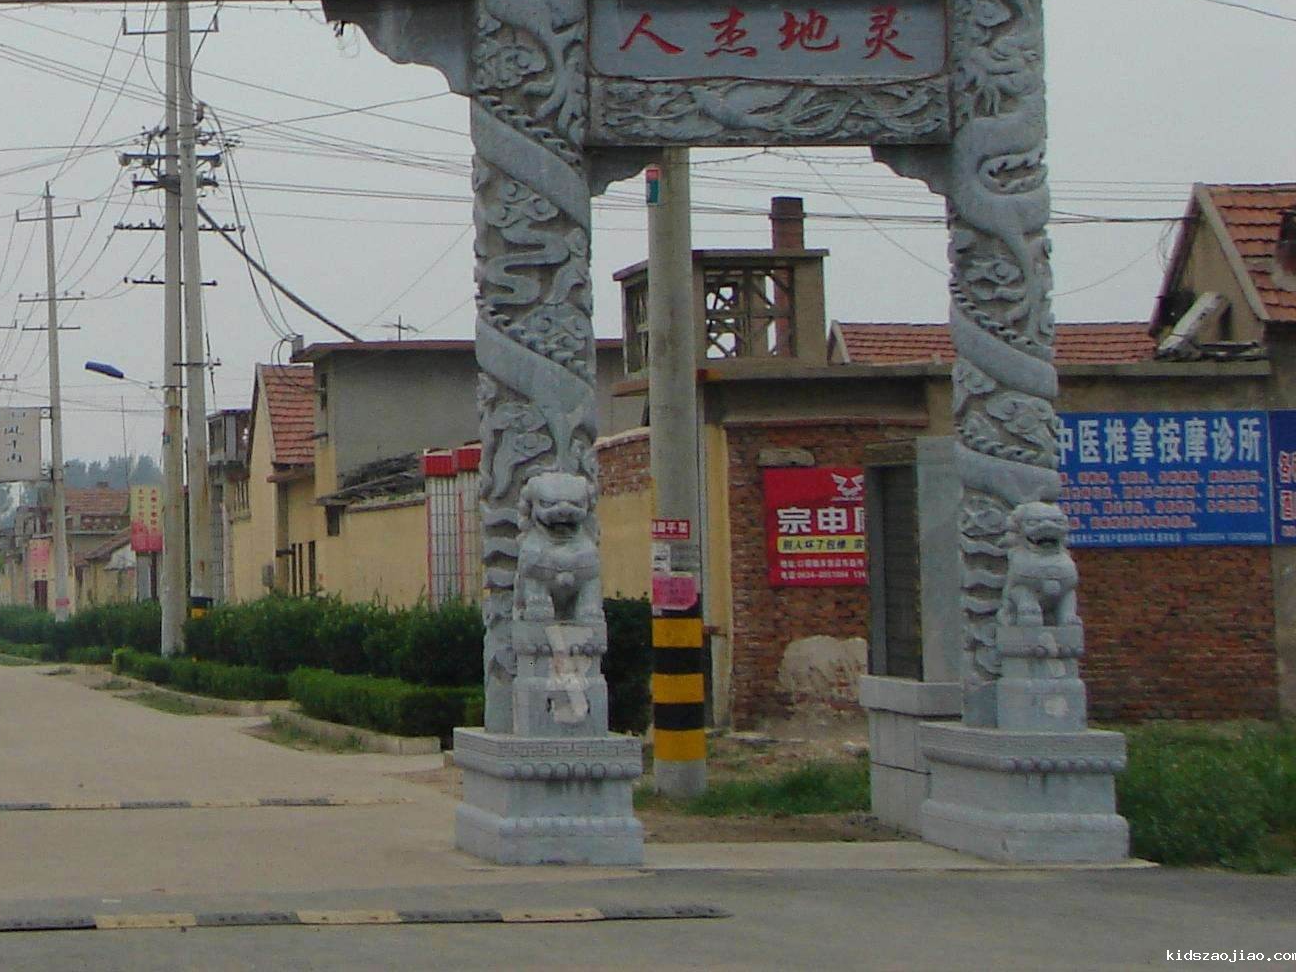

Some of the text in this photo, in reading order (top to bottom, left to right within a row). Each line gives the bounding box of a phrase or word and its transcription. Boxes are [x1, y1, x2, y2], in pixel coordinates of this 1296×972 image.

[619, 5, 915, 61] 人杰地灵
[1055, 416, 1261, 465] 中医推拿按摩诊所
[776, 506, 865, 533] 宗申
